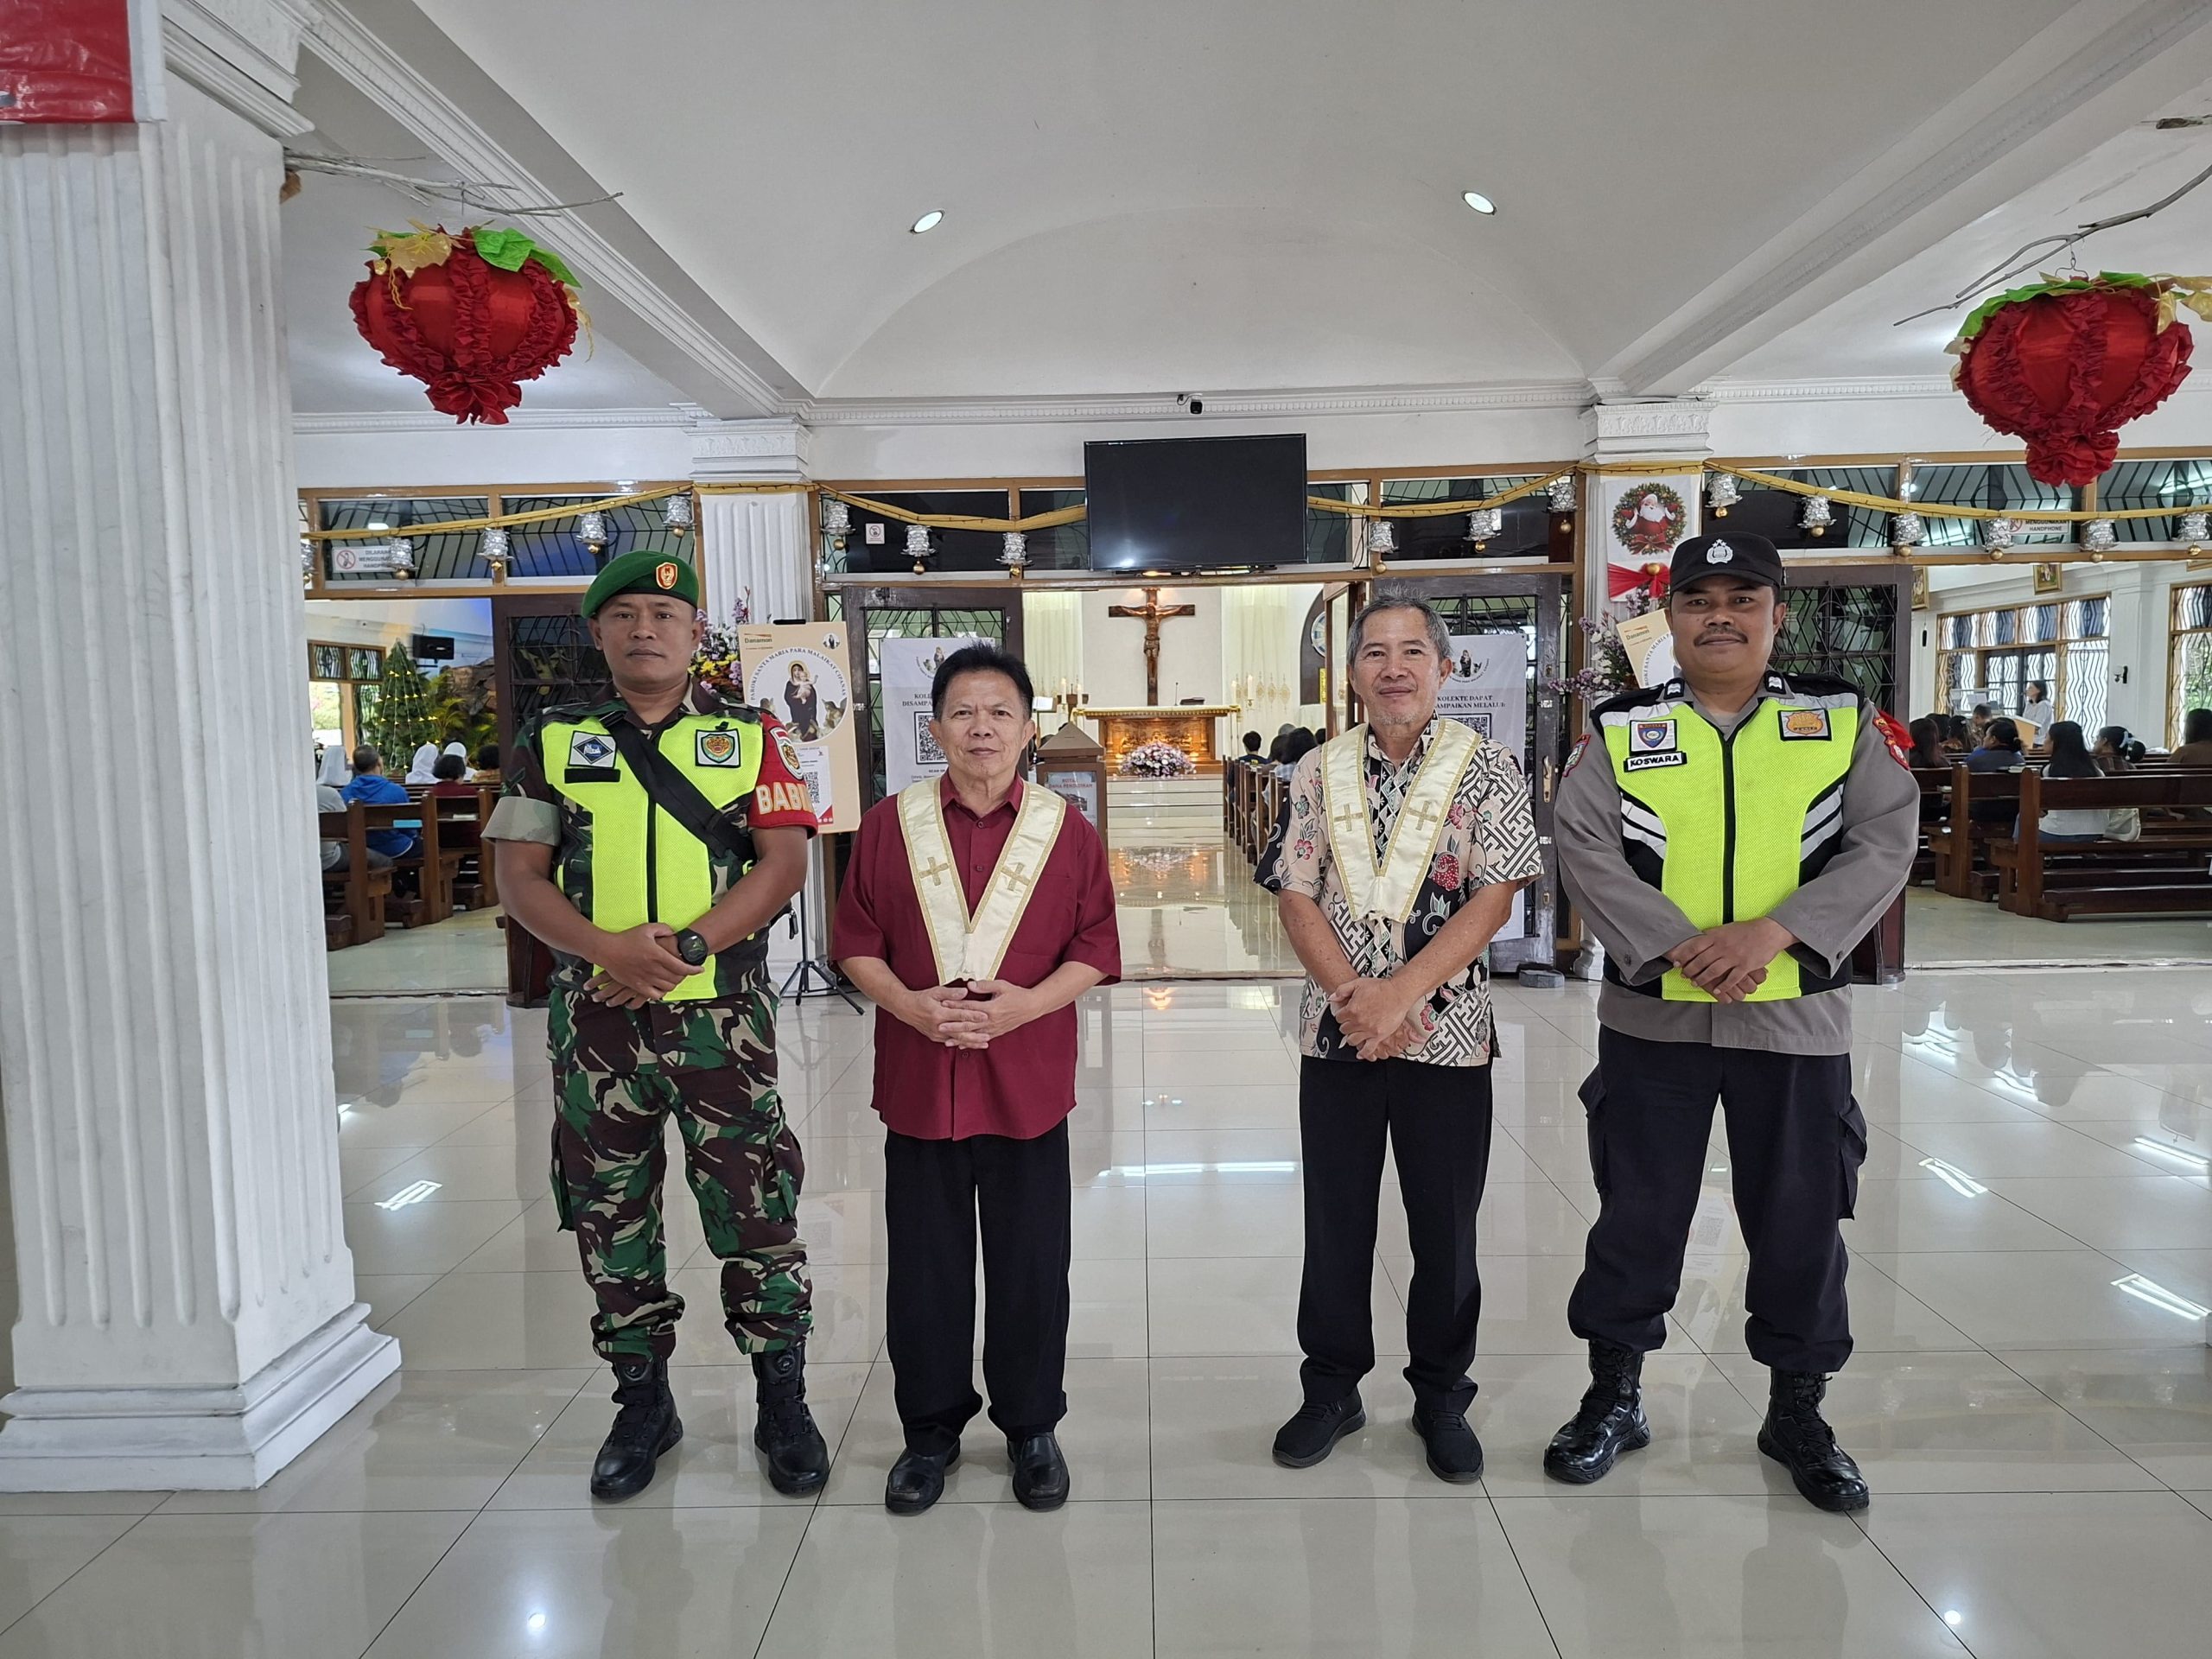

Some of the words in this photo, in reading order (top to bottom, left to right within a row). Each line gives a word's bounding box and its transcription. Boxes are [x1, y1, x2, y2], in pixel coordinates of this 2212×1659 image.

[1626, 629, 1649, 640] Danamon
[754, 659, 770, 677] SANTA
[768, 649, 790, 661] MARIA
[807, 649, 837, 670] MALAIKAT
[835, 670, 847, 696] CIPANAS
[1630, 754, 1680, 767] KOSWARA
